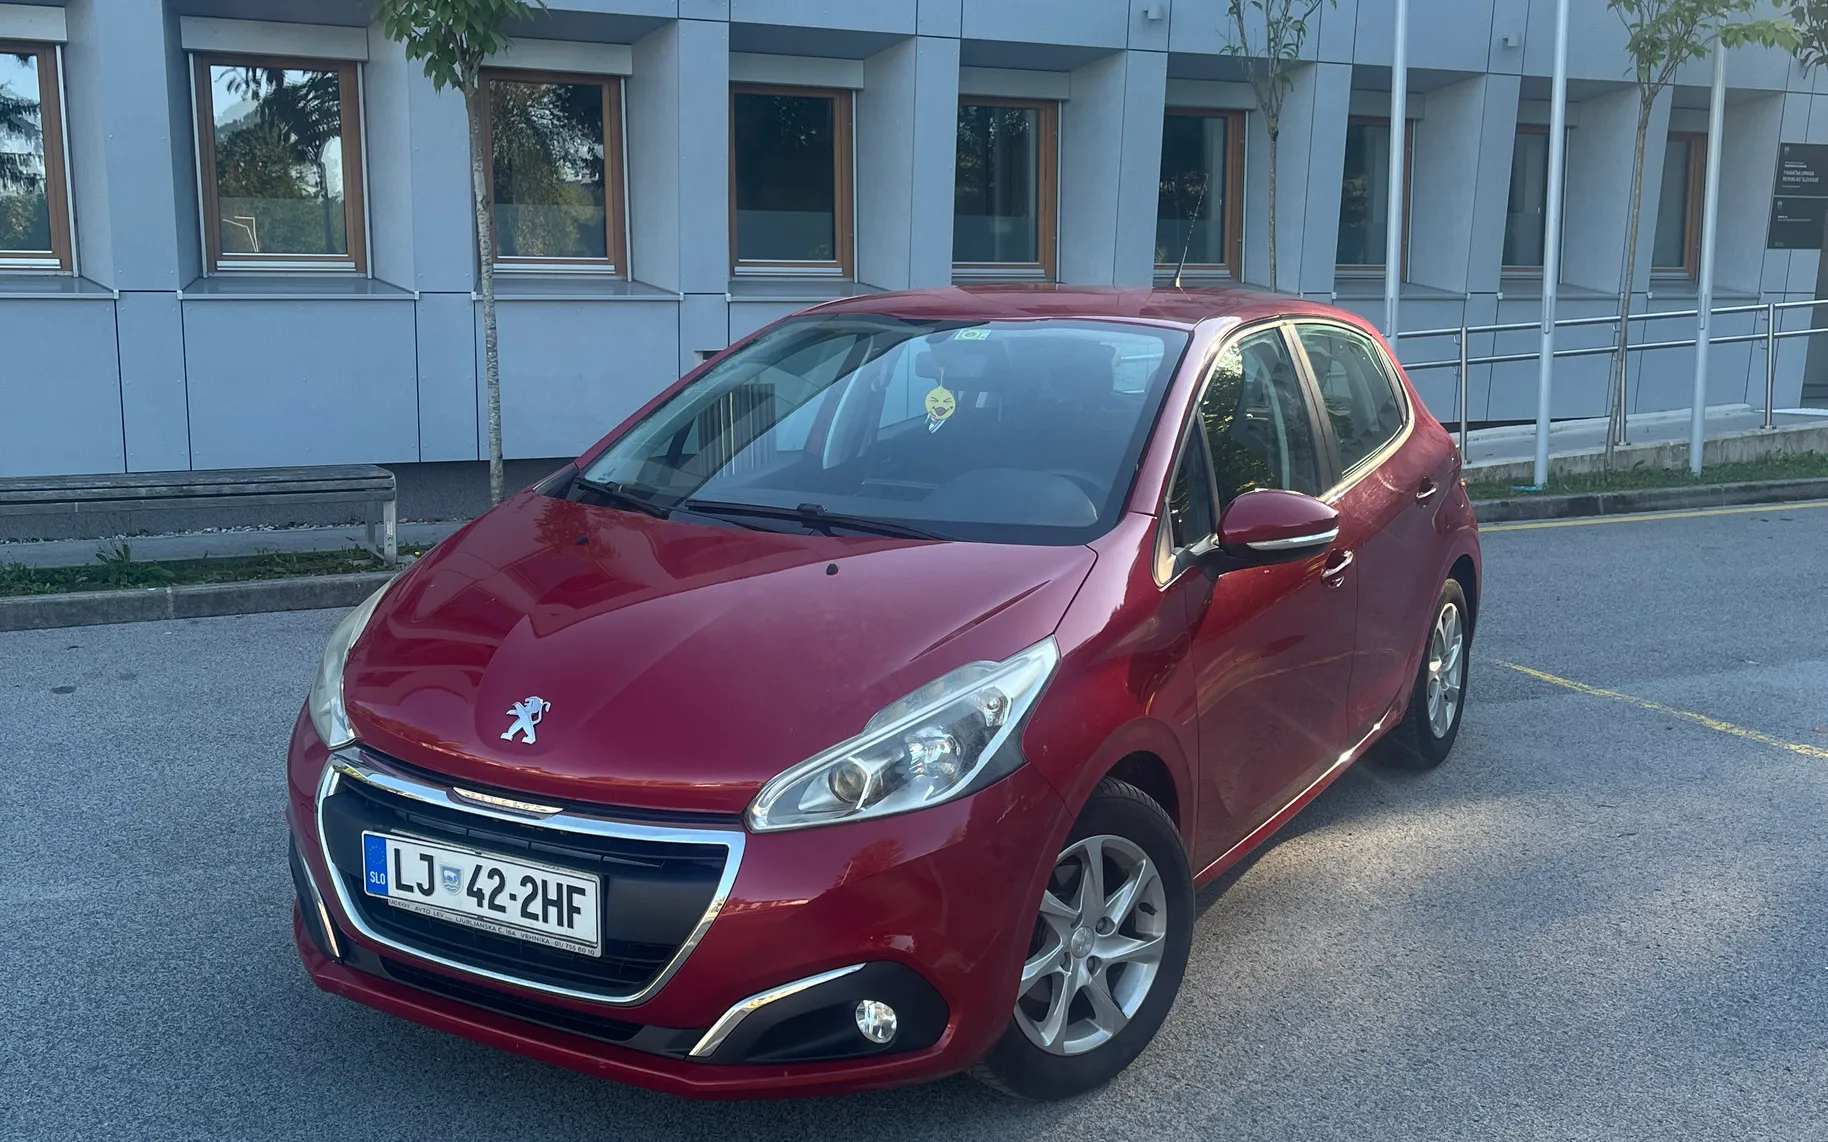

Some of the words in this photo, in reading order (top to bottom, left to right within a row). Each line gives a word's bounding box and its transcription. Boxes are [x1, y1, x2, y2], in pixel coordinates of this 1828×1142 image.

[369, 870, 386, 885] SLO
[394, 848, 435, 897] LJ
[466, 864, 586, 930] 42-2HF
[414, 905, 431, 915] AVTO
[433, 910, 445, 918] LEV
[455, 916, 497, 932] LJUBLJANSKA
[520, 932, 551, 945] VRHNIKA
